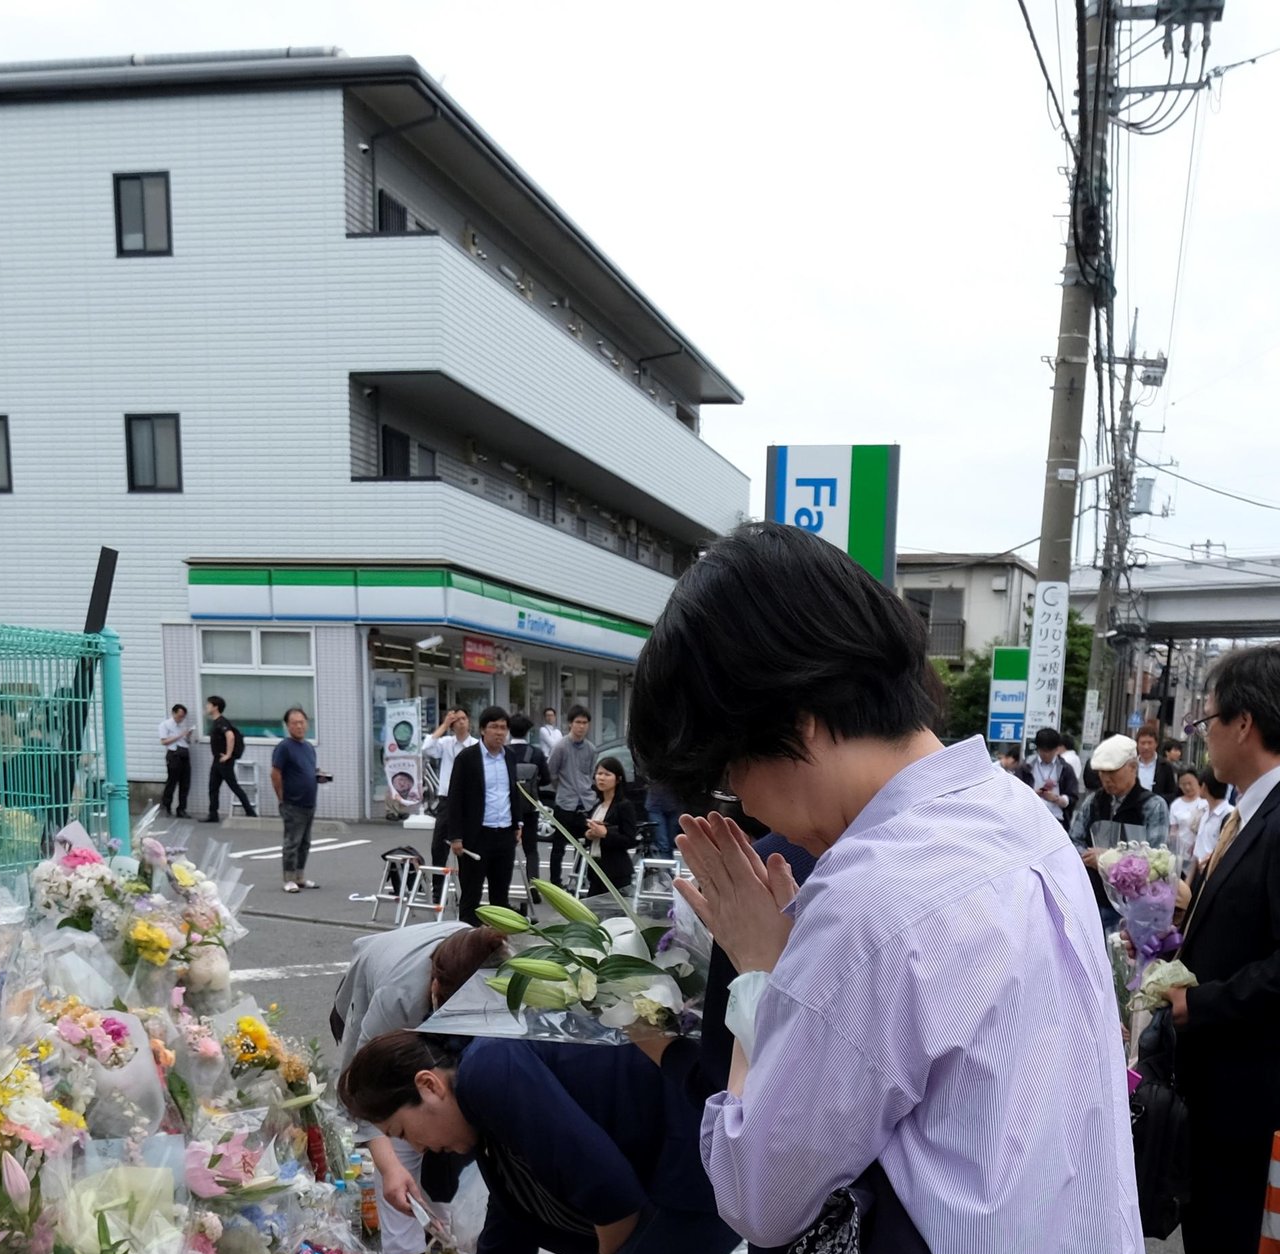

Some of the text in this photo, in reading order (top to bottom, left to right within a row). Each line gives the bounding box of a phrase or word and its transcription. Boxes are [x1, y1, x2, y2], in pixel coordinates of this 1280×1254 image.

[527, 613, 556, 636] FamilyMart
[1034, 611, 1052, 692] クリニック
[1045, 611, 1064, 709] ちひろ皮膚科
[994, 690, 1025, 703] Famil
